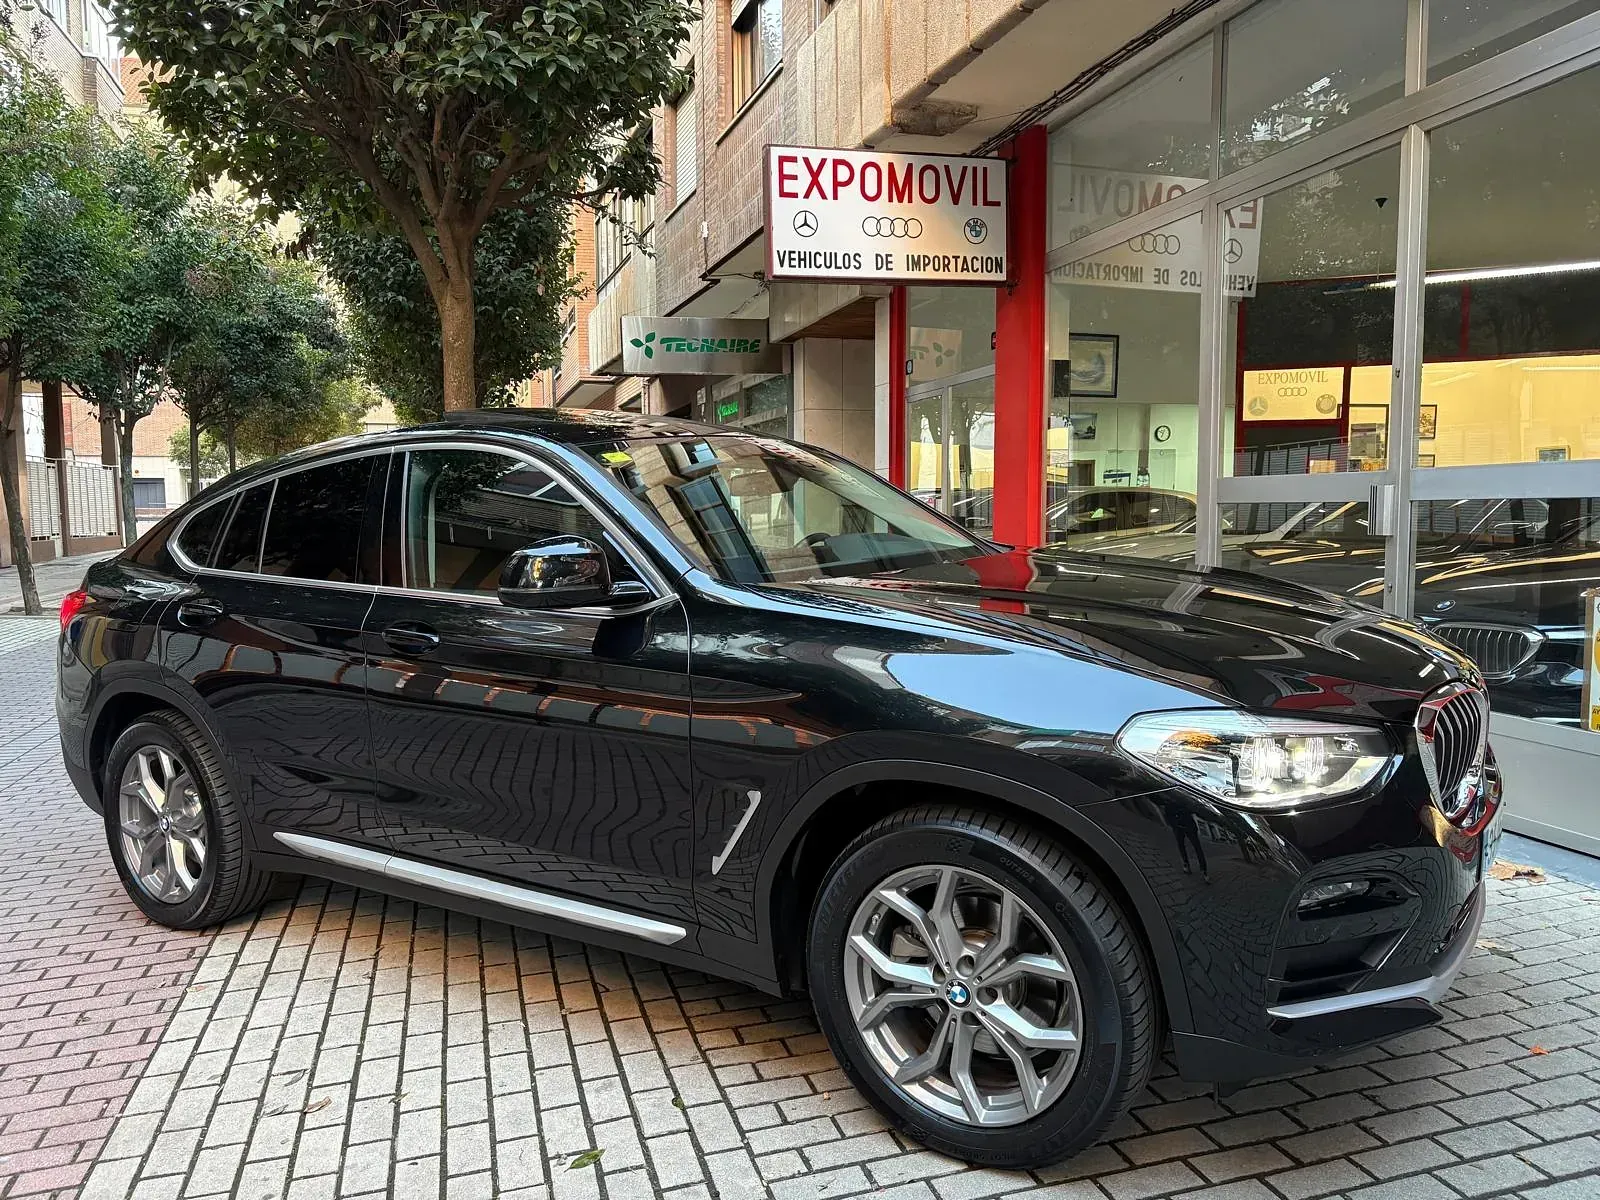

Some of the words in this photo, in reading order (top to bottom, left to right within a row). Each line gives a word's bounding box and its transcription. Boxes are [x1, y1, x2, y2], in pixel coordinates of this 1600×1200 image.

[778, 155, 1001, 206] EXPOMOVIL
[777, 250, 862, 270] VEHICULOS
[875, 253, 894, 271] DE
[906, 254, 1004, 274] IMPORTACION
[660, 337, 761, 353] TECNAIRE
[1258, 371, 1328, 384] EXPOMOVIL
